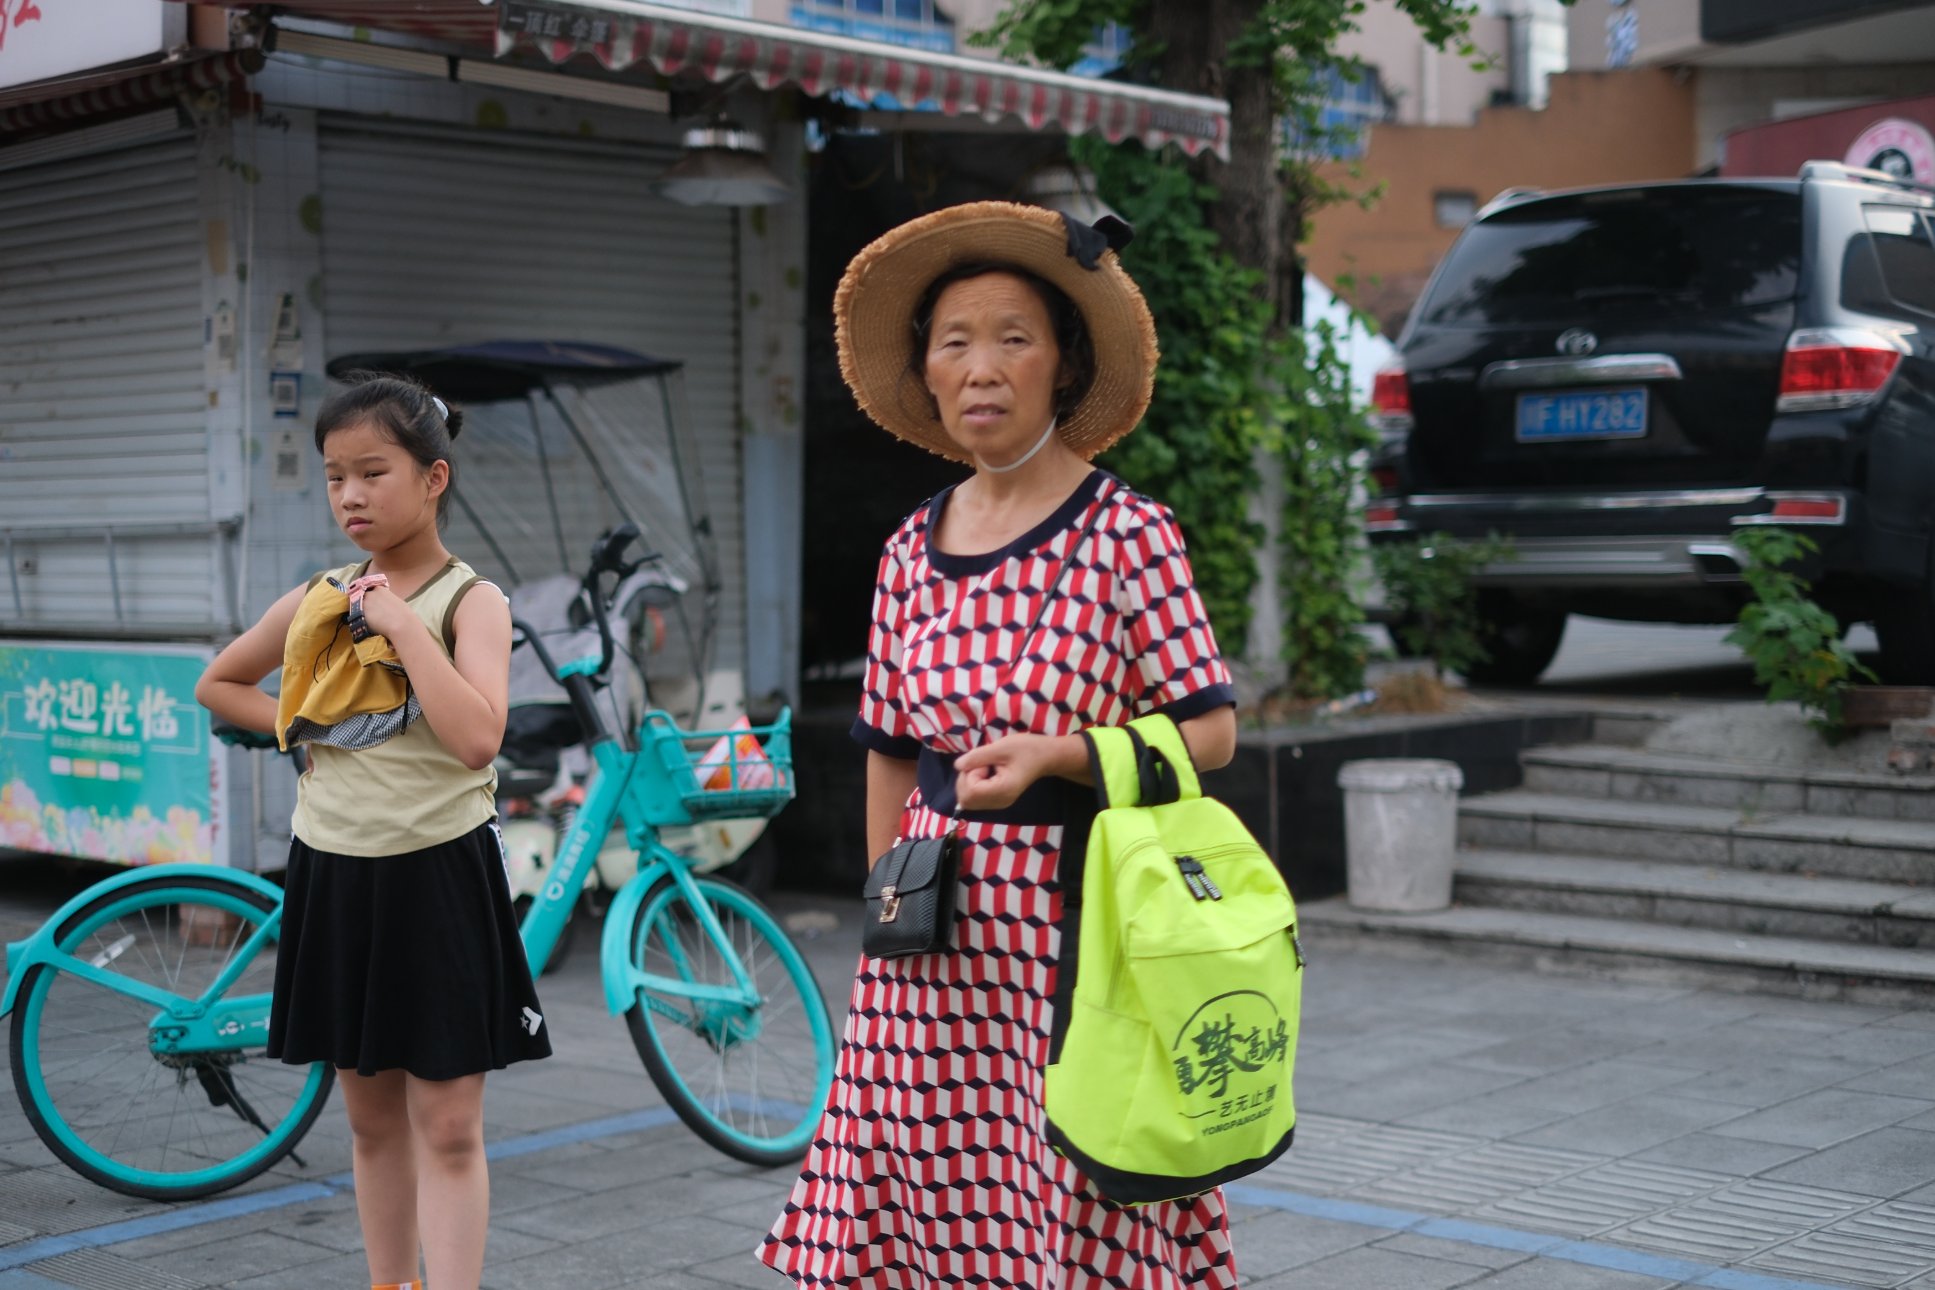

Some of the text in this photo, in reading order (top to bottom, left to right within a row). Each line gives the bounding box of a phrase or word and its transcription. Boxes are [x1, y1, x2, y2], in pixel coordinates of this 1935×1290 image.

[24, 677, 178, 741] 欢迎光临
[1173, 1012, 1289, 1098] 勇攀高峰
